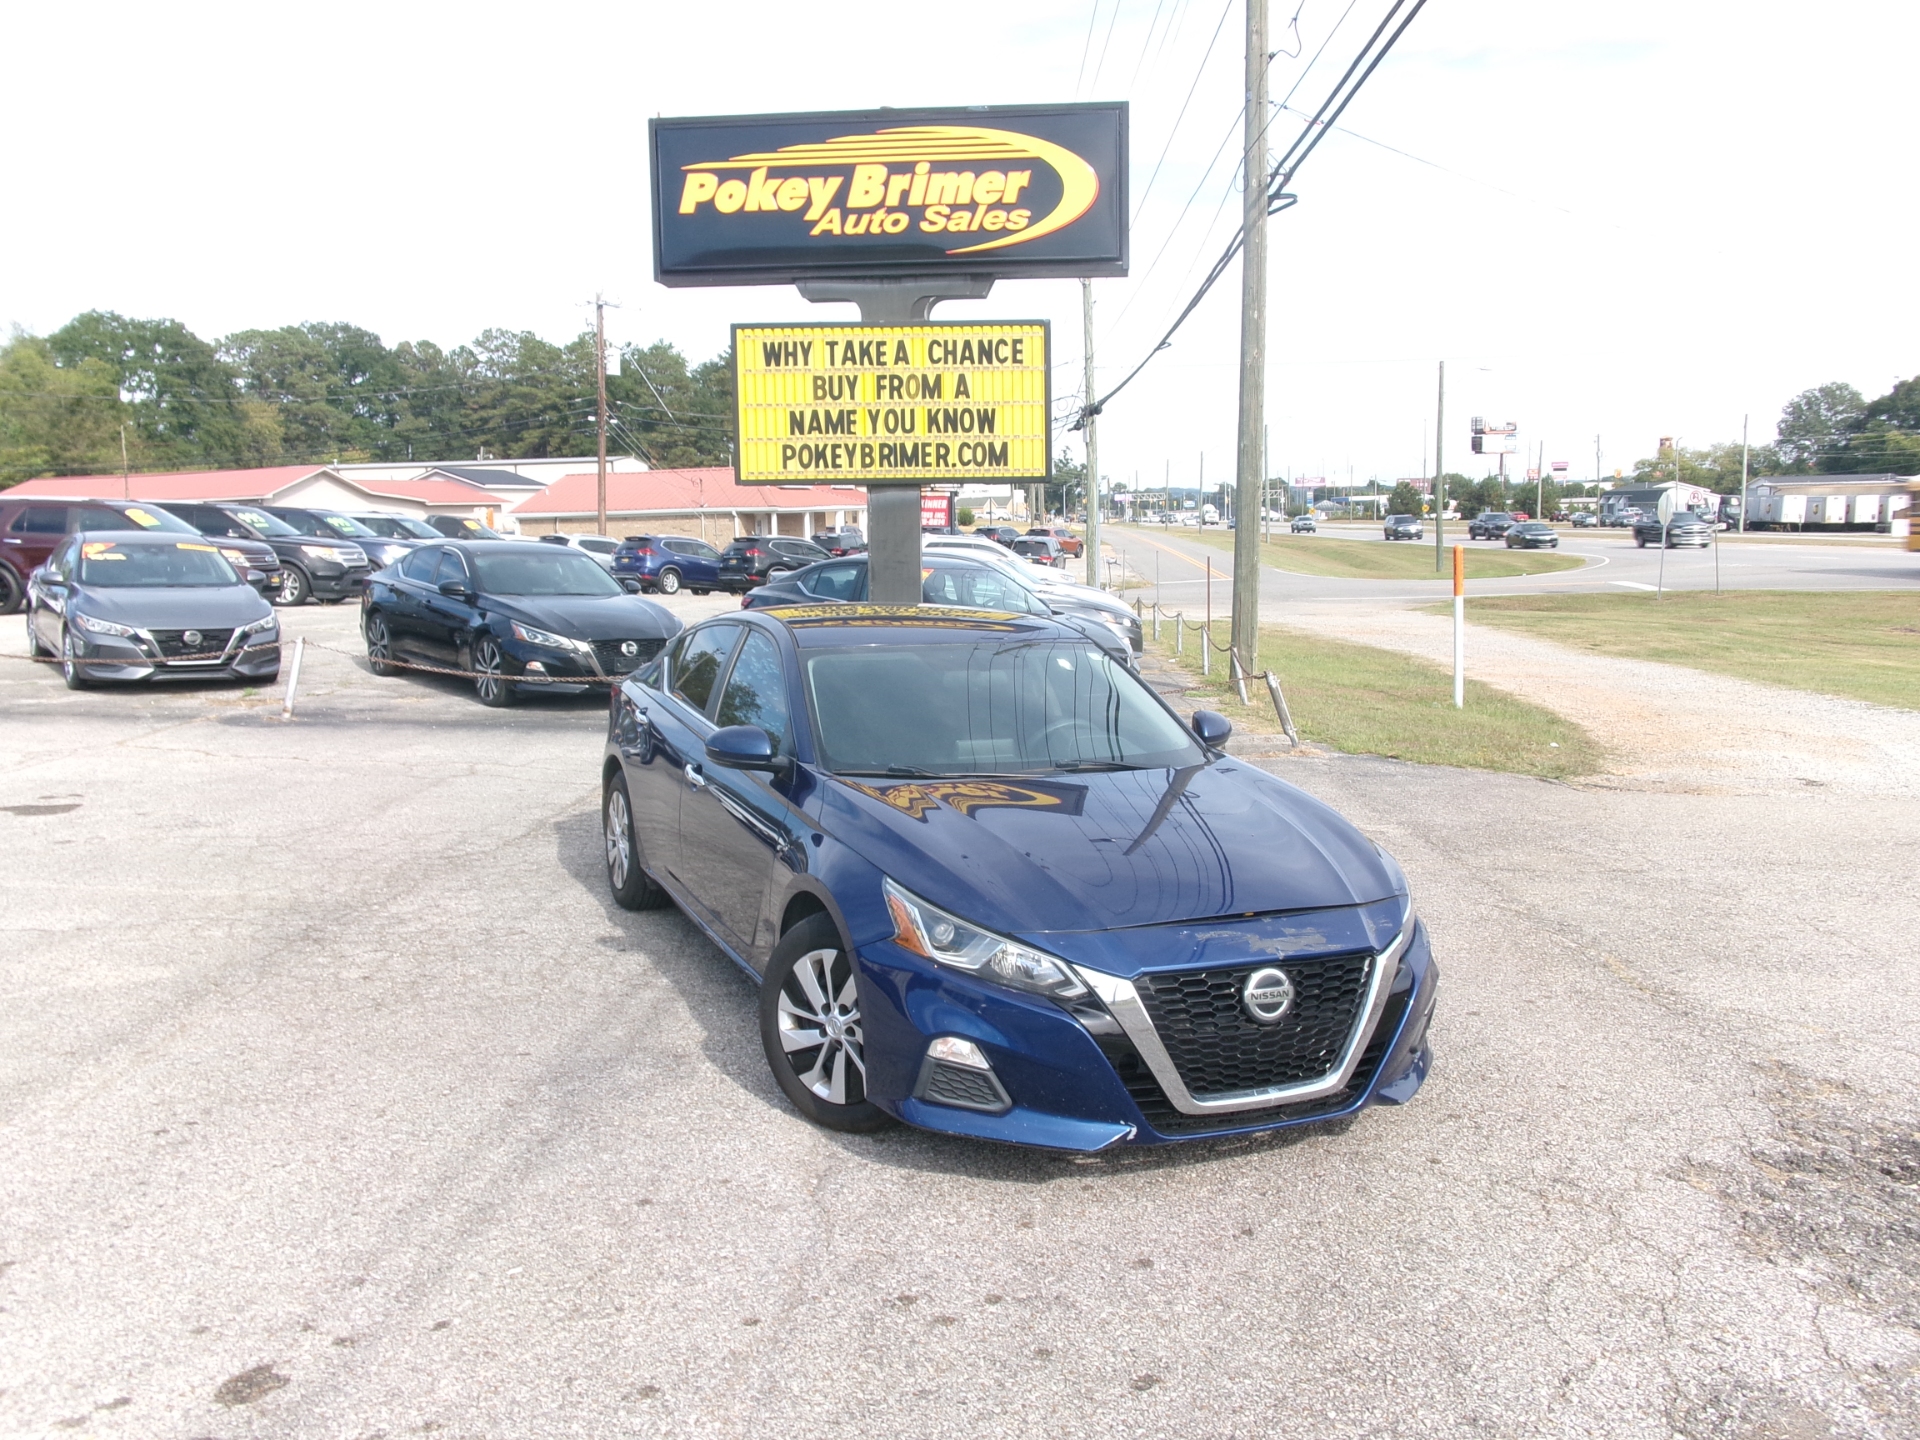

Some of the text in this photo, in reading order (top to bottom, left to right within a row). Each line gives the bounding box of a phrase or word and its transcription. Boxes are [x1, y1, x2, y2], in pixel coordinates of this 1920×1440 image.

[678, 161, 1032, 221] Pokey Brimer
[809, 204, 1032, 236] Auto Sales
[762, 338, 1023, 367] WHY TAKE A CHANCE
[812, 373, 970, 401] BUY FROM A
[789, 407, 996, 436] NAME YOU KNOW
[781, 441, 1008, 470] POKEYBRIMER.COM
[1250, 989, 1290, 1001] NISSAN
